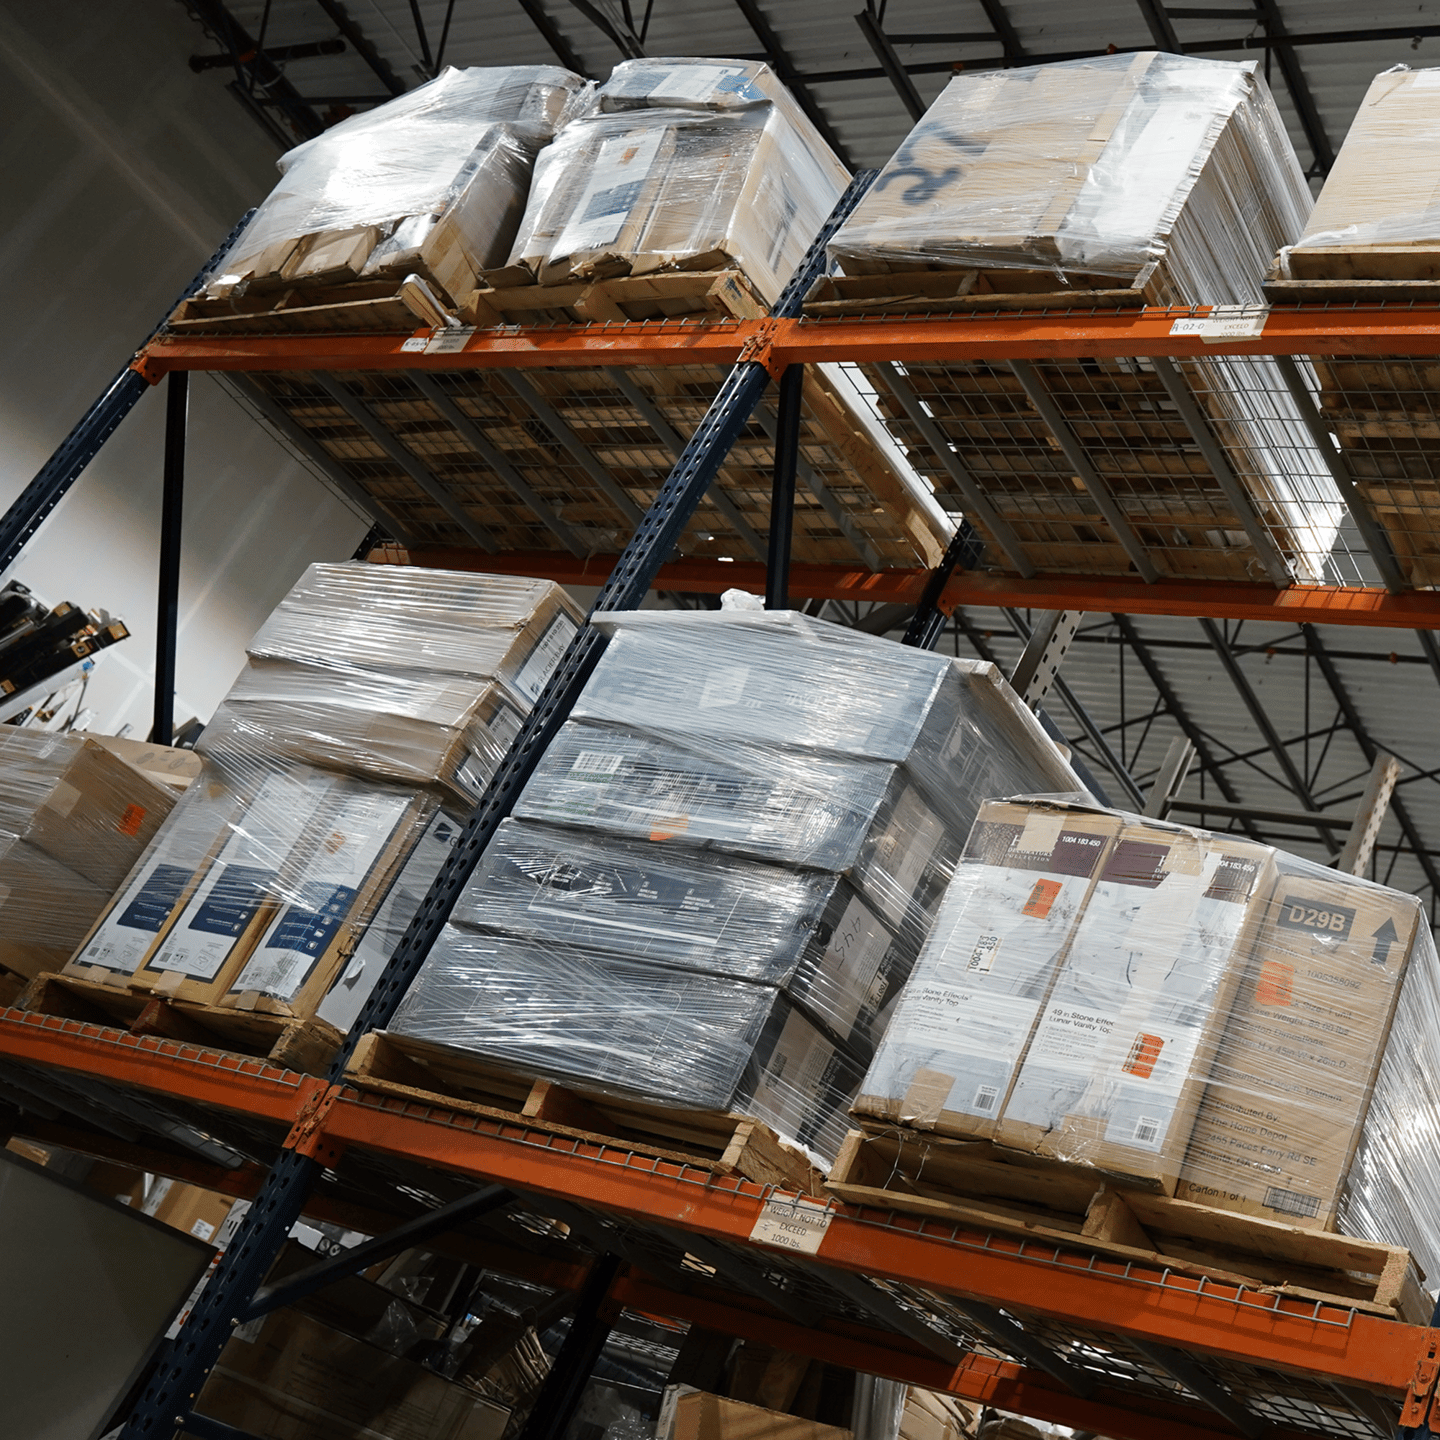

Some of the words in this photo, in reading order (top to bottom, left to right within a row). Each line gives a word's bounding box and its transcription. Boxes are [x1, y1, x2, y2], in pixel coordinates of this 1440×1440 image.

[1288, 905, 1346, 932] D29B
[969, 935, 990, 970] 1004-183
[946, 998, 959, 1007] Top
[1051, 1008, 1063, 1016] 49
[1070, 1011, 1095, 1023] Stone
[1095, 1016, 1115, 1027] Effec
[1073, 1020, 1098, 1031] Vanity
[1230, 1120, 1258, 1135] Home
[1260, 1127, 1288, 1141] Depot
[1303, 1155, 1318, 1167] SE
[1188, 1182, 1219, 1197] Carton
[1221, 1190, 1226, 1199] 1
[1229, 1191, 1239, 1201] of
[770, 1205, 798, 1219] WEIGHT
[799, 1213, 816, 1224] NOT
[816, 1218, 828, 1229] TO
[779, 1222, 808, 1236] EXCEED
[771, 1233, 790, 1245] 1000
